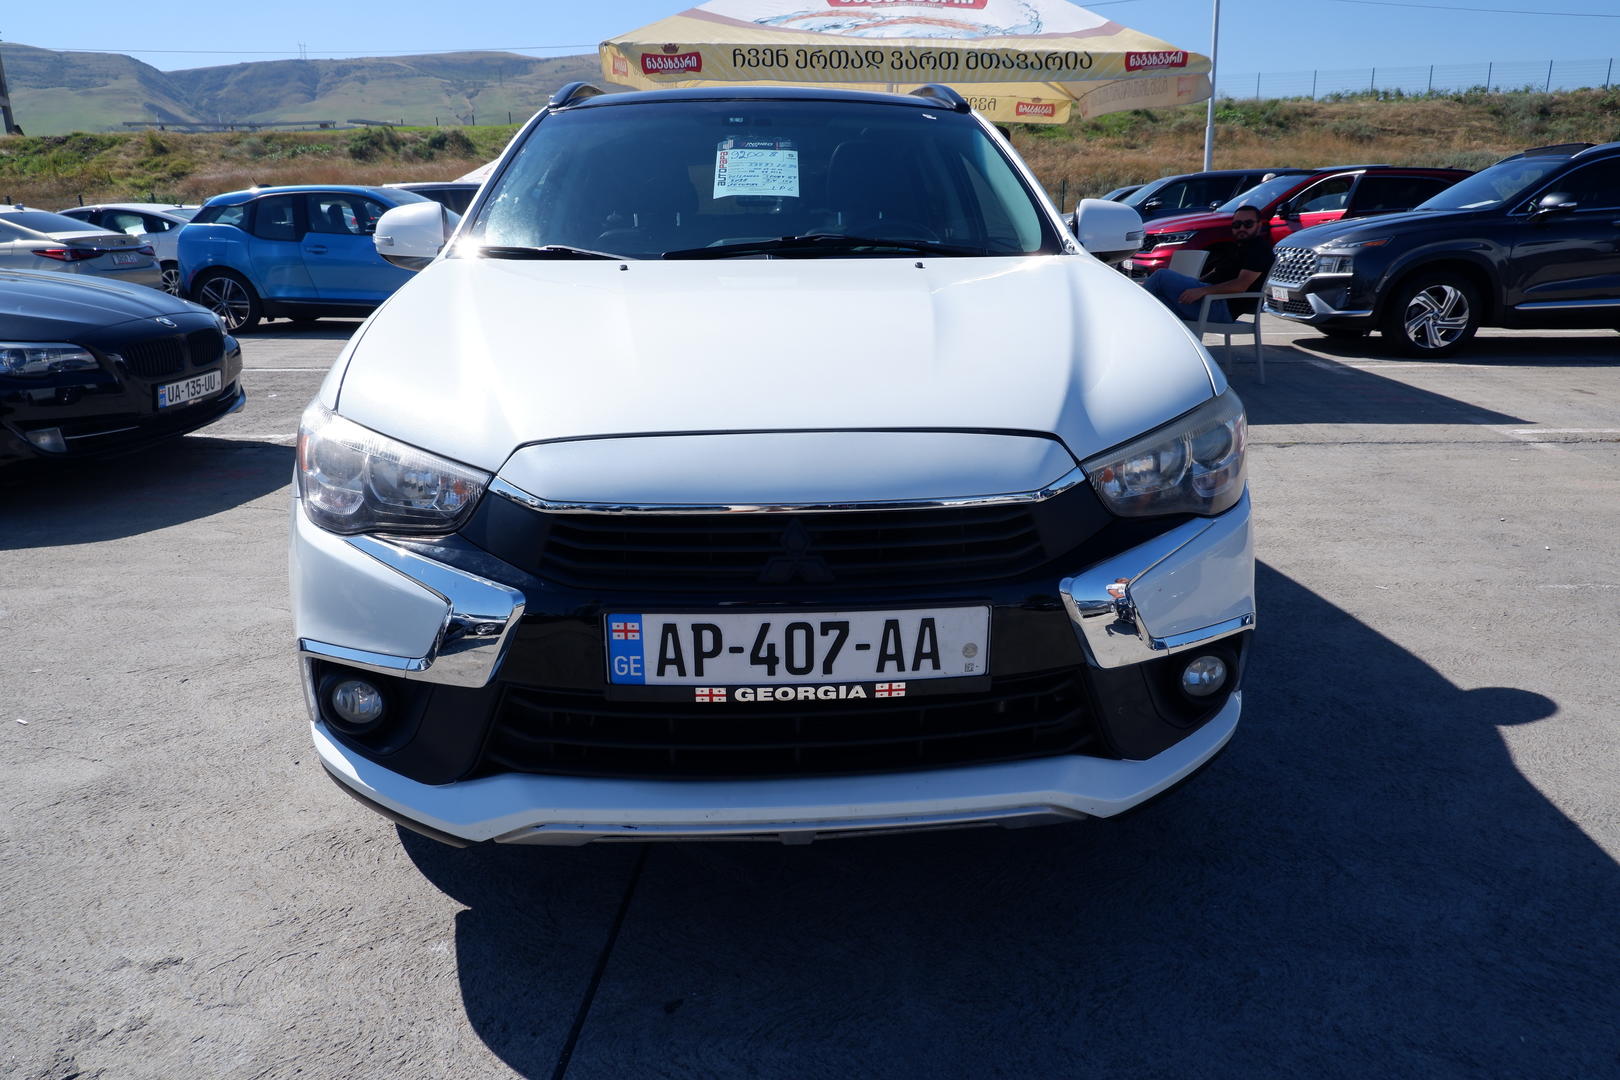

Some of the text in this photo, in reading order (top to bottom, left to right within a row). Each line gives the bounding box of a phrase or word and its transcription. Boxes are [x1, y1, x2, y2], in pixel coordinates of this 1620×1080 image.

[645, 55, 698, 70] ნატახტარი
[732, 48, 1094, 71] ჩვენ ერთად ვართ მთავარია
[1128, 51, 1184, 67] ნატახტარი
[167, 374, 216, 403] UA-135-UU
[614, 617, 942, 678] GE AP-407-AA
[734, 684, 867, 702] GEORGIA
